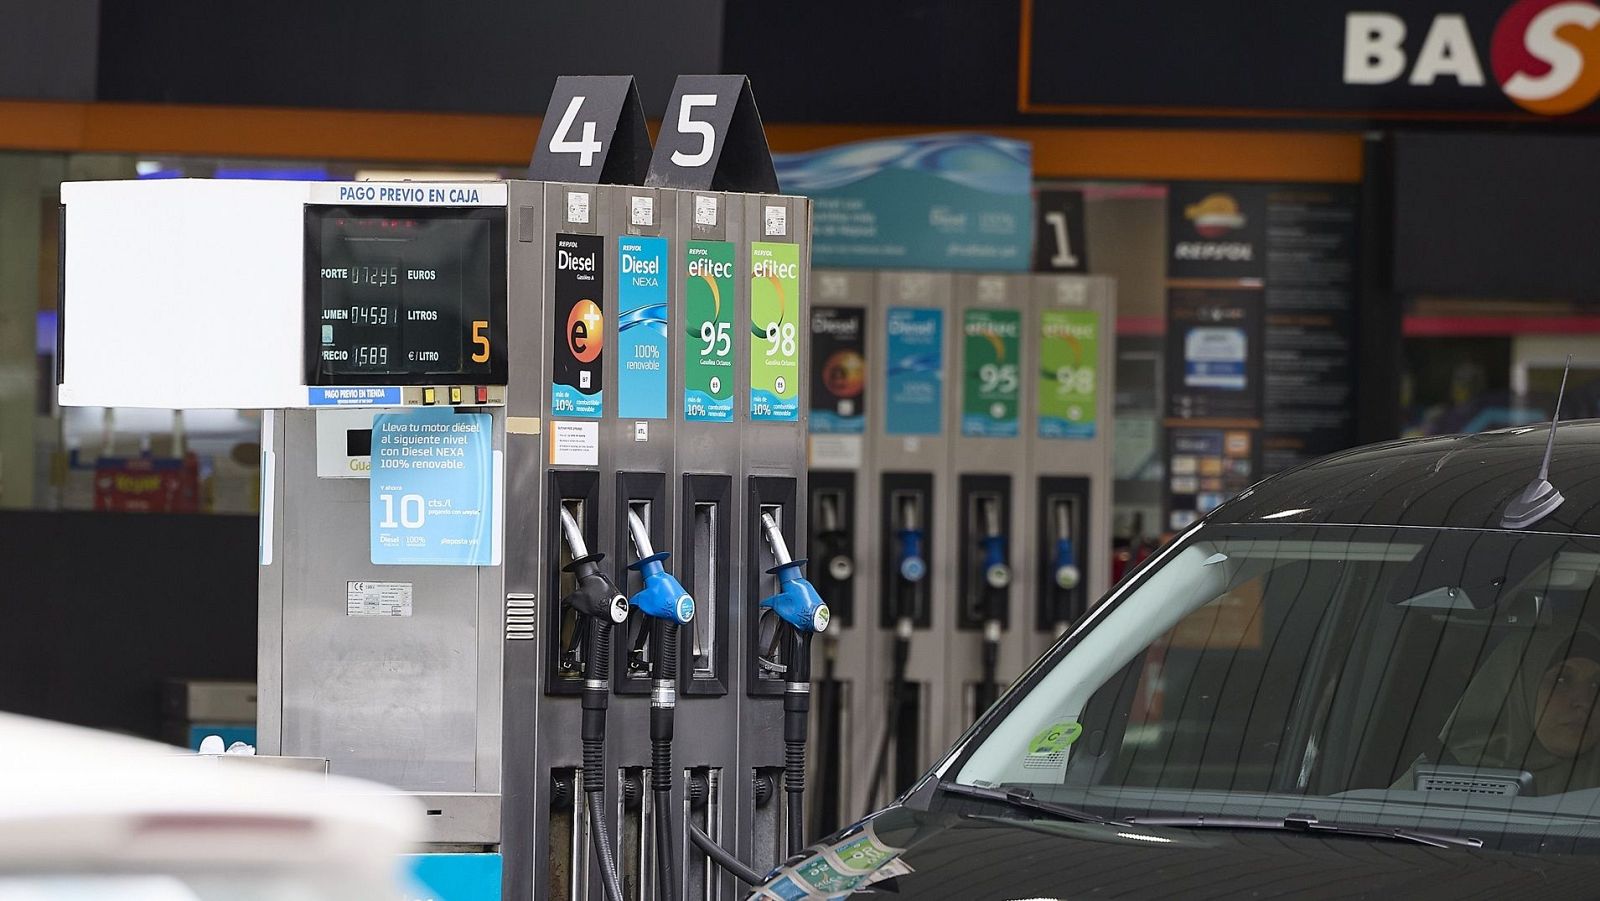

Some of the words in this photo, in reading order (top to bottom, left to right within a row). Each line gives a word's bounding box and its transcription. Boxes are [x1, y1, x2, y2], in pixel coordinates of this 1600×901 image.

[548, 96, 602, 167] 4
[670, 94, 717, 167] 5
[340, 187, 375, 201] PAGO
[380, 188, 424, 202] PREVIO
[429, 189, 445, 203] EN
[450, 189, 479, 203] CAJA
[1045, 211, 1078, 267] 1
[558, 250, 595, 272] Diesel
[622, 254, 659, 274] Diesel
[688, 258, 733, 278] efitec
[408, 270, 436, 280] EUROS
[753, 259, 797, 279] efitec
[632, 277, 659, 287] NEXA
[322, 309, 348, 319] UMEN
[408, 310, 438, 320] LITROS
[471, 320, 490, 363] 5
[700, 320, 731, 357] 95
[766, 321, 796, 357] 98
[322, 351, 348, 361] RECIO
[634, 344, 660, 358] 100%
[626, 360, 660, 370] renovable
[980, 363, 1017, 393] 95
[1056, 365, 1094, 394] 98
[324, 389, 340, 399] PAGO
[340, 389, 358, 399] PREVIO
[360, 389, 367, 398] EN
[367, 388, 385, 398] TIENDA
[555, 399, 574, 411] 10%
[687, 404, 706, 416] 10%
[753, 404, 771, 416] 10%
[382, 423, 408, 432] Lleva
[409, 423, 420, 432] tu
[421, 424, 449, 432] motor
[451, 422, 480, 433] diésel
[381, 434, 391, 444] al
[394, 434, 440, 446] siguiente
[443, 435, 468, 445] nivel
[380, 448, 399, 457] con
[401, 447, 433, 457] Diesel
[435, 448, 464, 457] NEXA
[380, 459, 409, 469] 100%
[379, 494, 425, 529] 10
